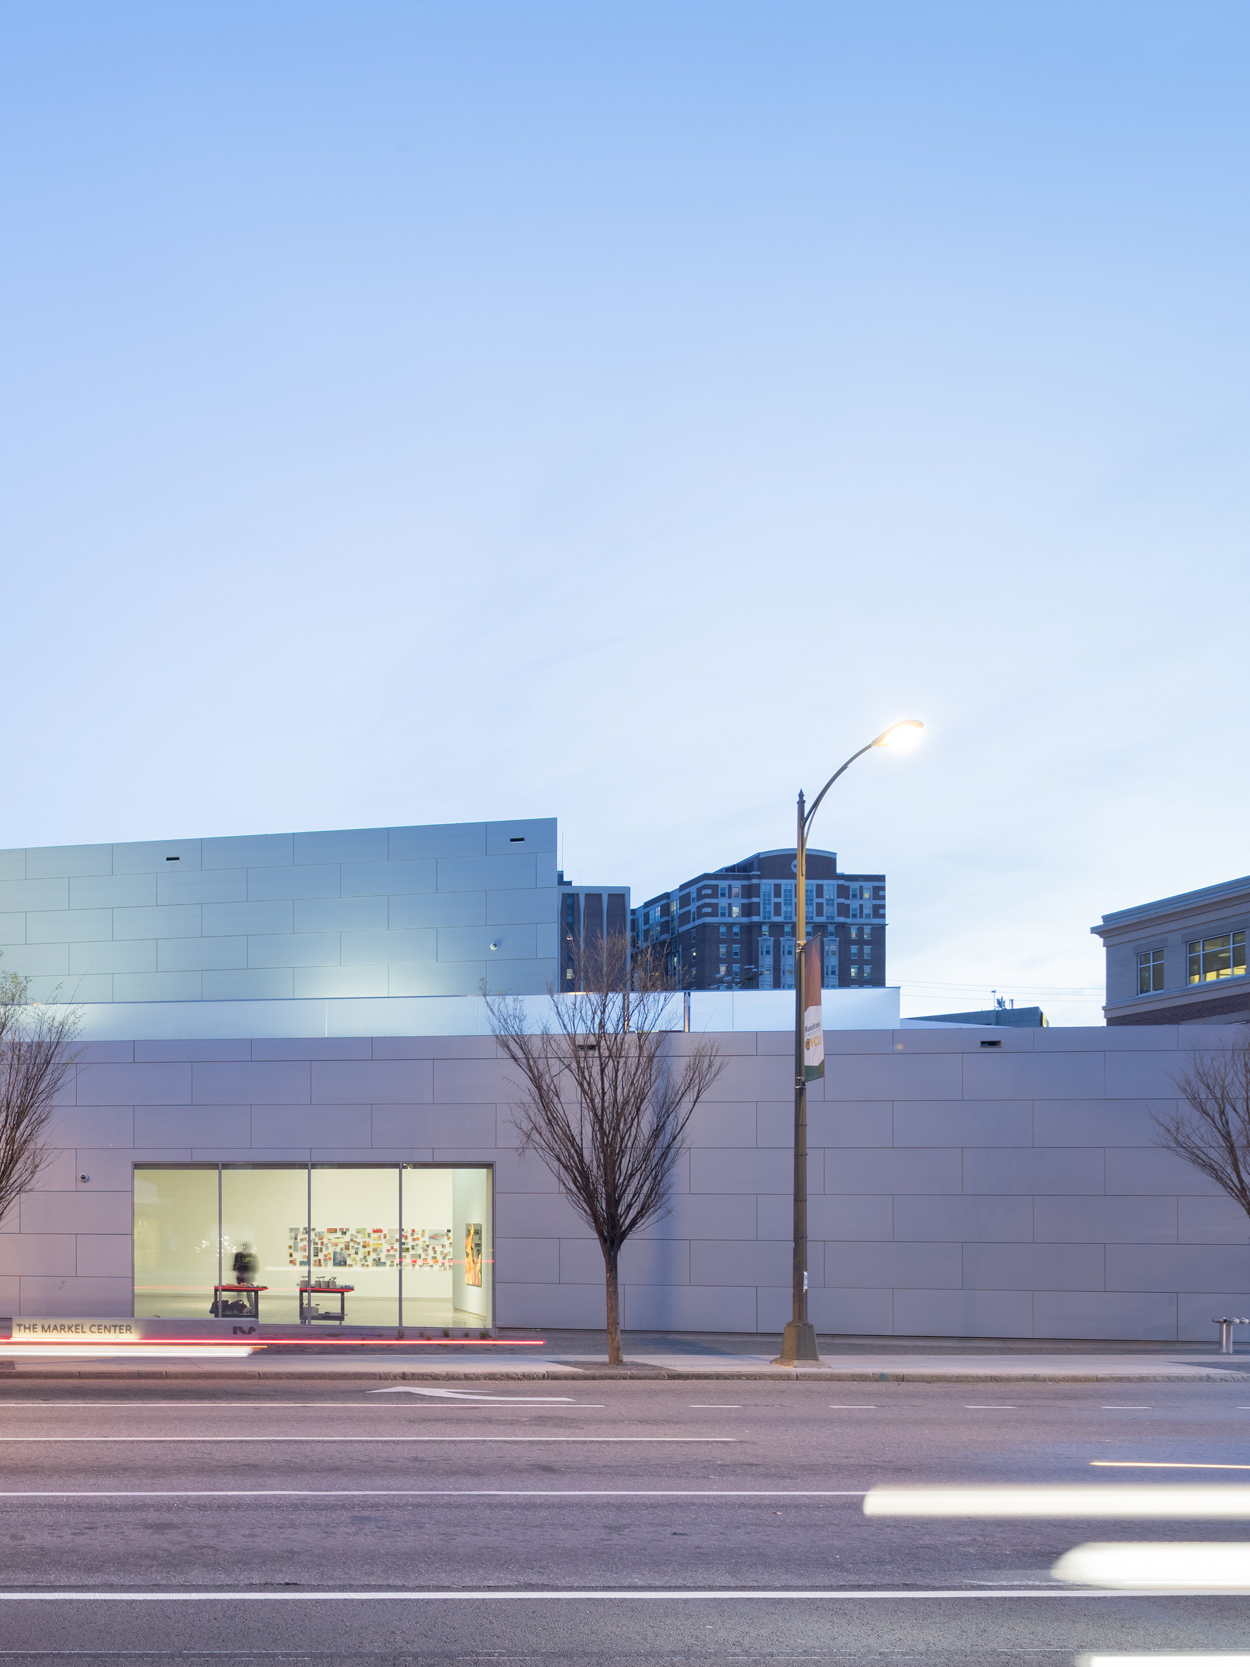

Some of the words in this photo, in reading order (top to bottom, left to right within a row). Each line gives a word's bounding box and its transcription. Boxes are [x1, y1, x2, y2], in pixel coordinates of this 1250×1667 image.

[16, 1324, 38, 1333] THE
[41, 1324, 86, 1333] MARKEL
[89, 1324, 132, 1334] CENTER
